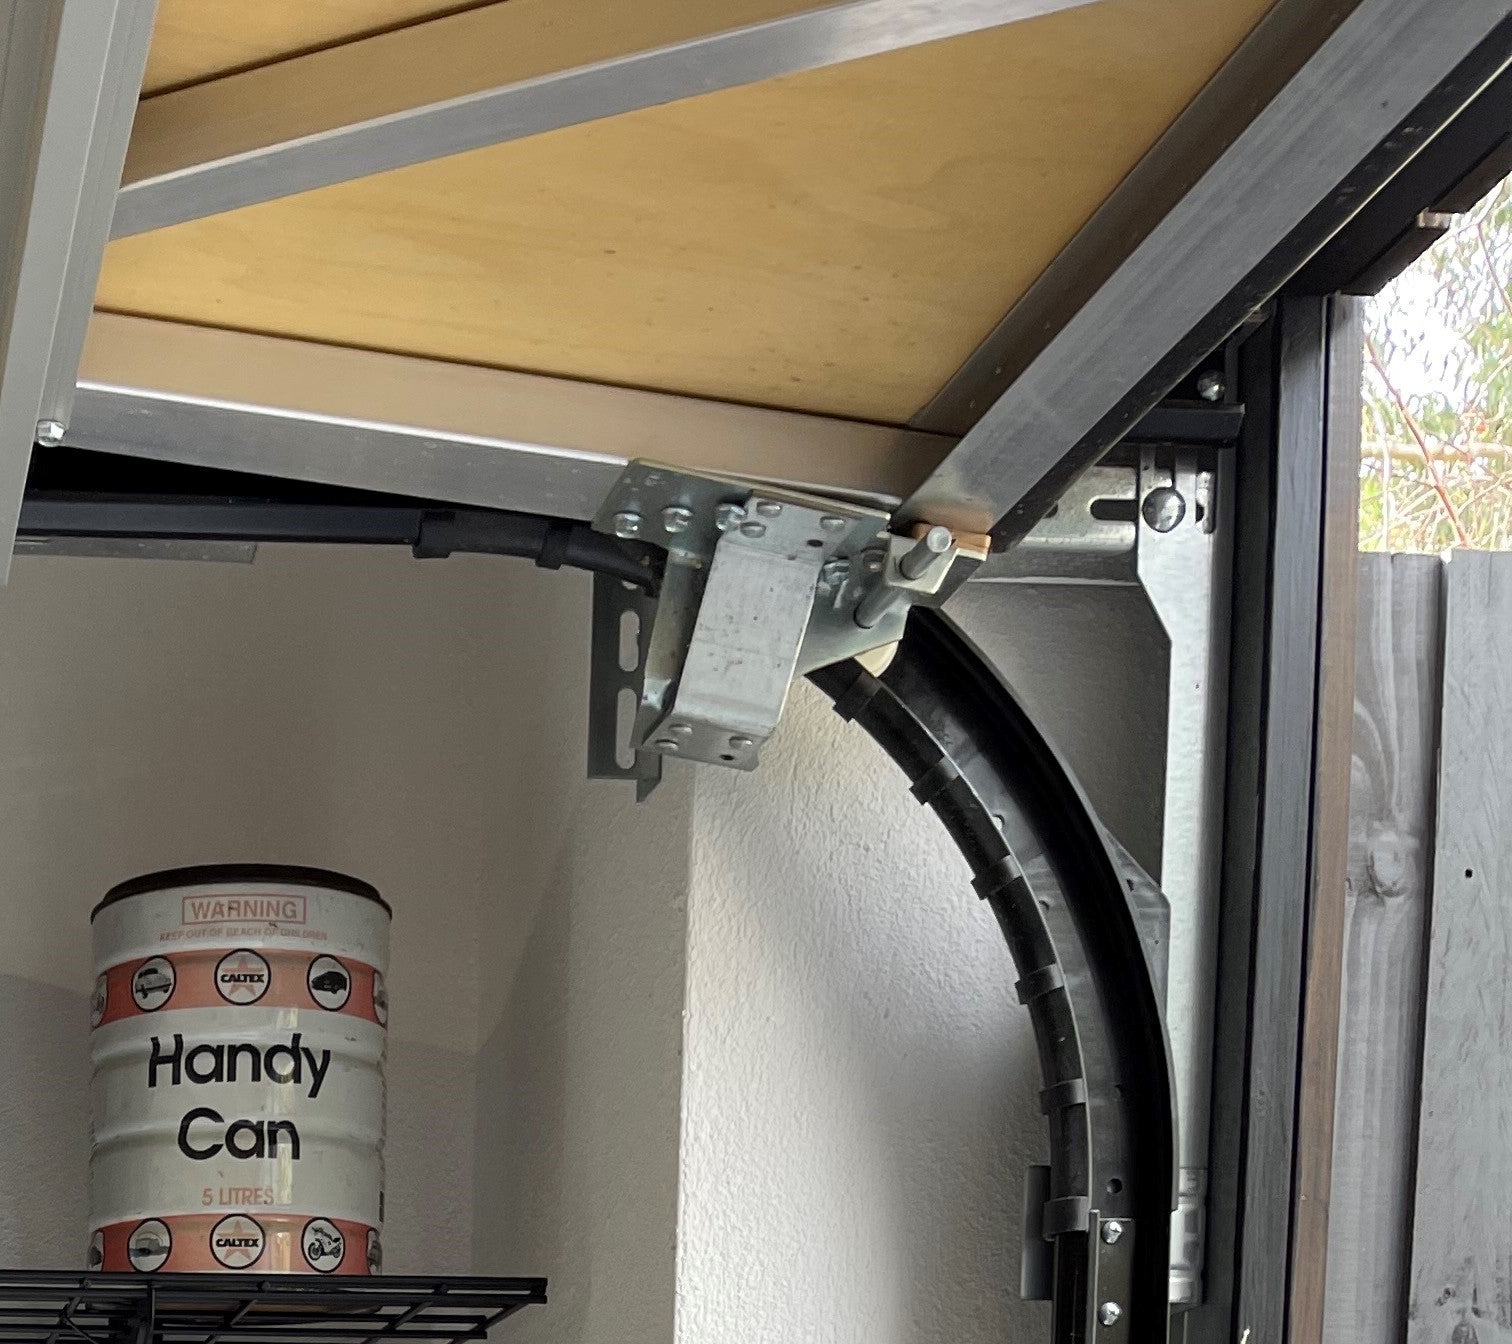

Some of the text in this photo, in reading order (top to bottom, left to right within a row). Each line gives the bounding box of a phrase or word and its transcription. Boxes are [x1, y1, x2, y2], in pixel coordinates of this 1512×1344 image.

[191, 899, 297, 920] WARNING
[221, 974, 265, 983] CALTEX
[148, 1033, 331, 1098] Handy
[178, 1107, 301, 1160] Can
[202, 1187, 275, 1206] 5 LITRES
[216, 1239, 259, 1247] CALTEX
